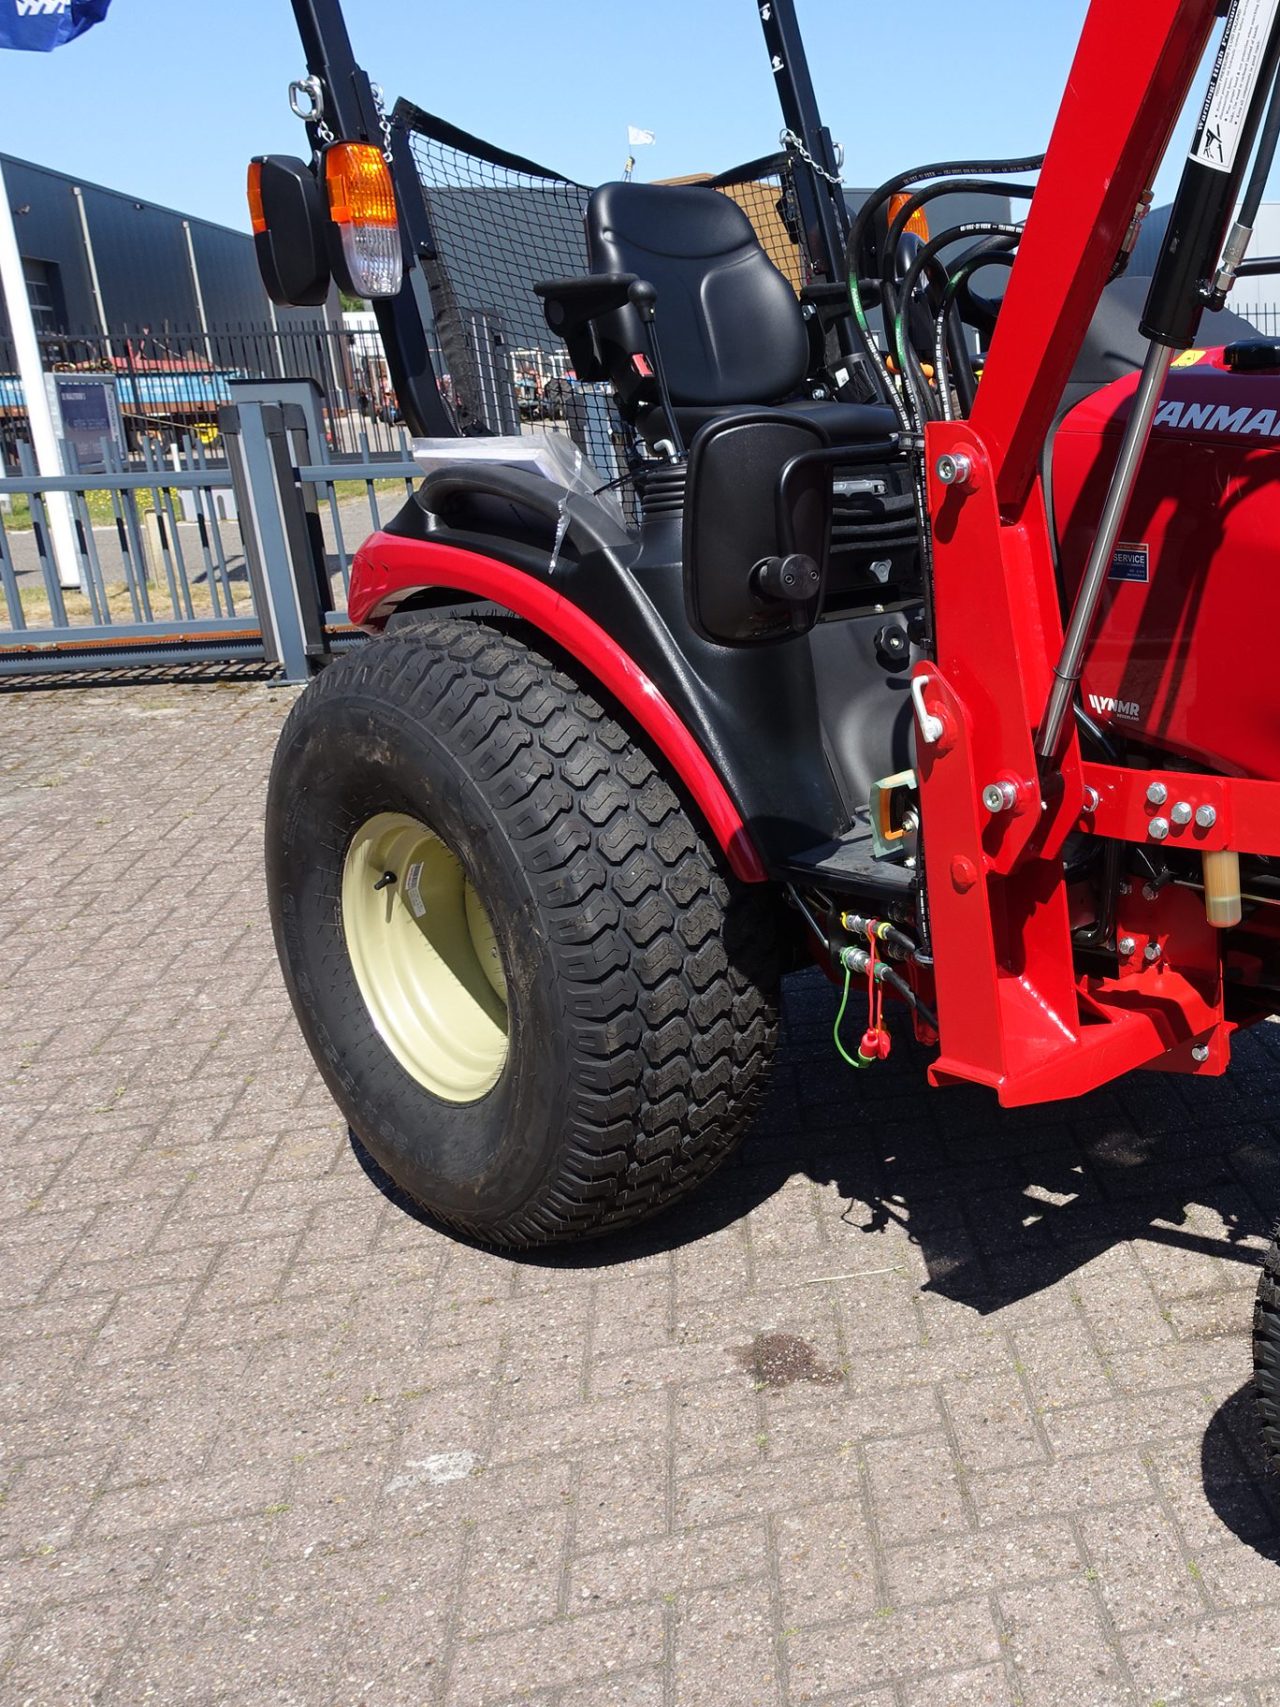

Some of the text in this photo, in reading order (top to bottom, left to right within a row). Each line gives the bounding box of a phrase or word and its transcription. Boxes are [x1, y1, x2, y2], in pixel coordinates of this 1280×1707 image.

[1198, 81, 1215, 130] Warning!
[1213, 50, 1223, 77] High
[1113, 553, 1145, 564] SERVICE
